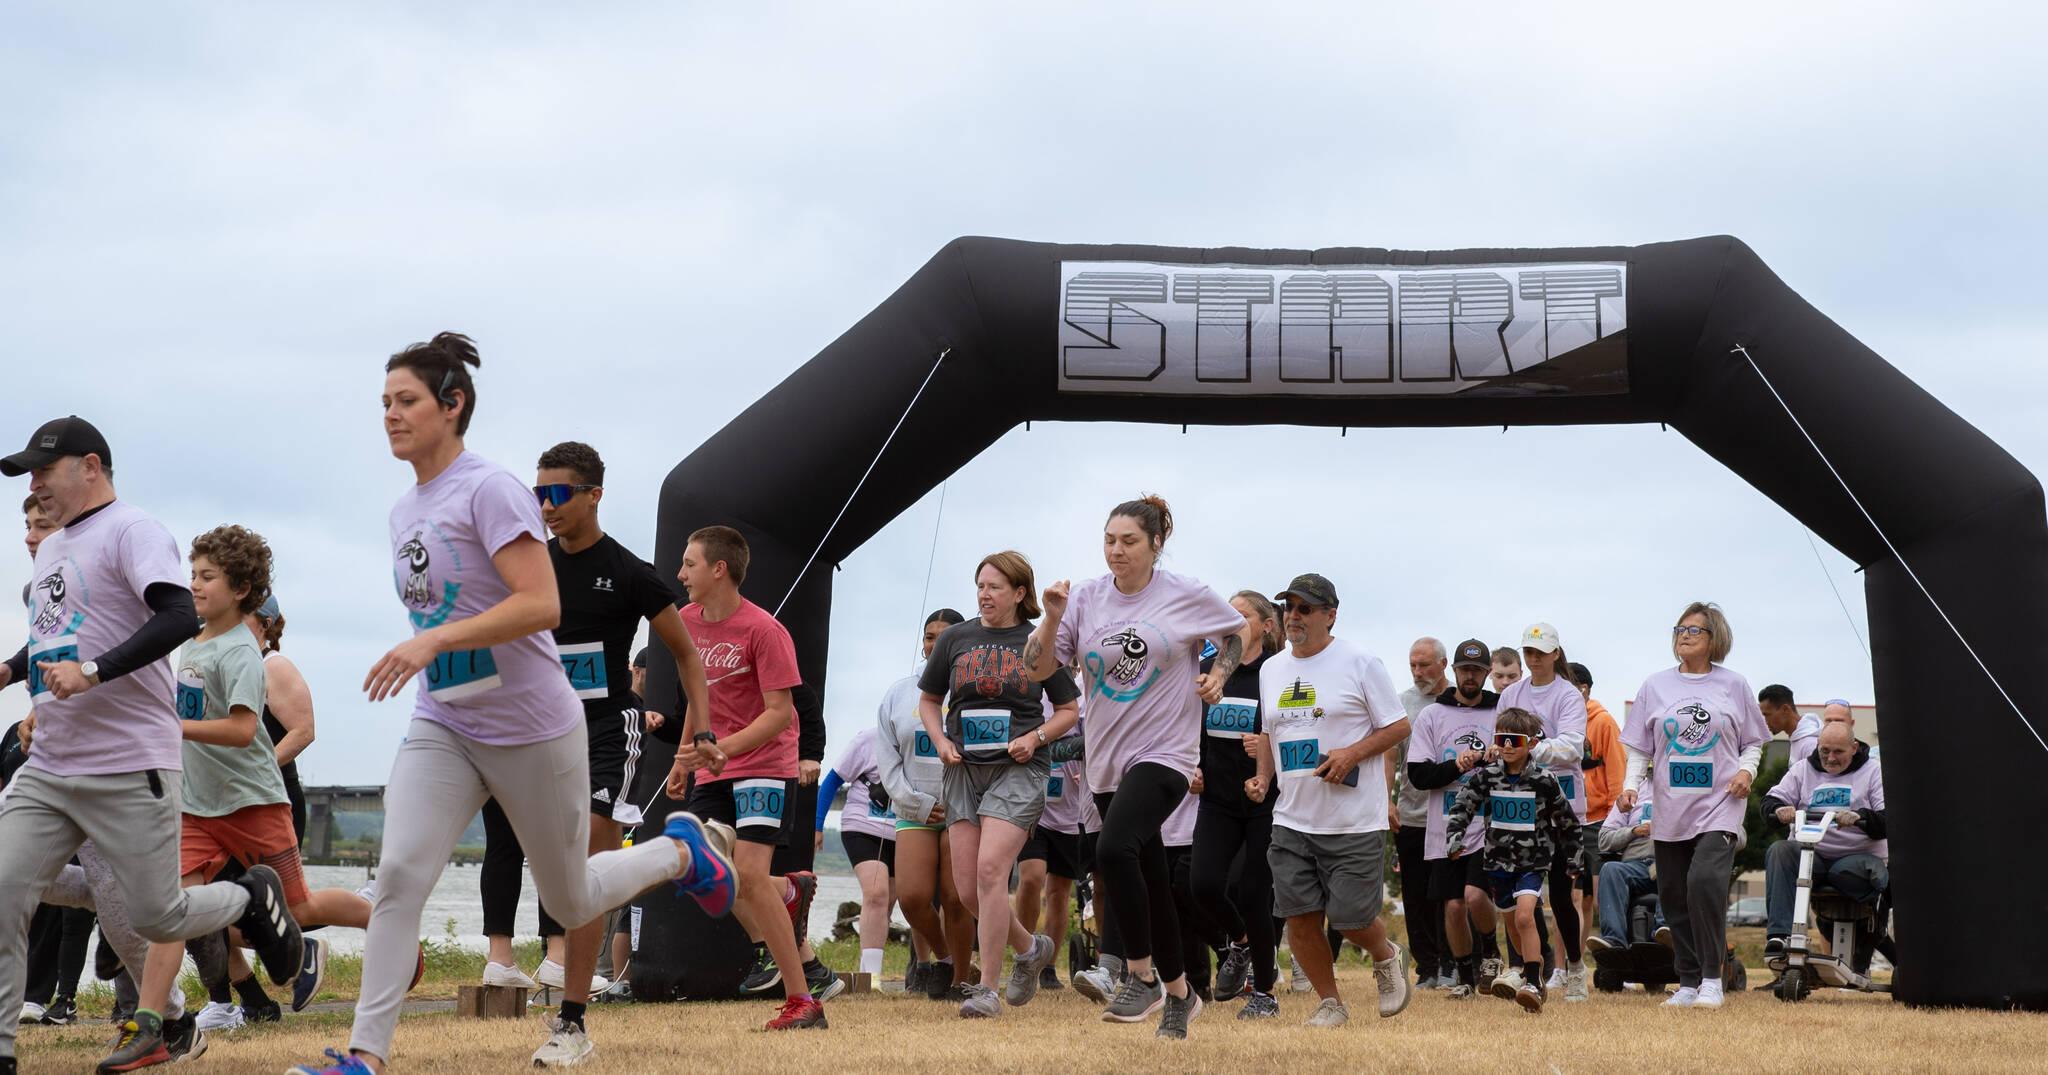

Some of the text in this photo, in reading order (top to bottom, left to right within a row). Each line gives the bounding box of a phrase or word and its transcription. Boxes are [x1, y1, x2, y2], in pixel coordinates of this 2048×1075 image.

[1064, 269, 1623, 383] START
[971, 644, 1018, 654] CHICAGO
[562, 656, 596, 684] 71
[954, 648, 1028, 694] BEARS
[1210, 706, 1250, 729] 066
[966, 719, 1005, 741] 029
[1280, 743, 1315, 768] 012
[1672, 765, 1709, 785] 063
[737, 790, 781, 814] 030
[1494, 799, 1531, 821] 008
